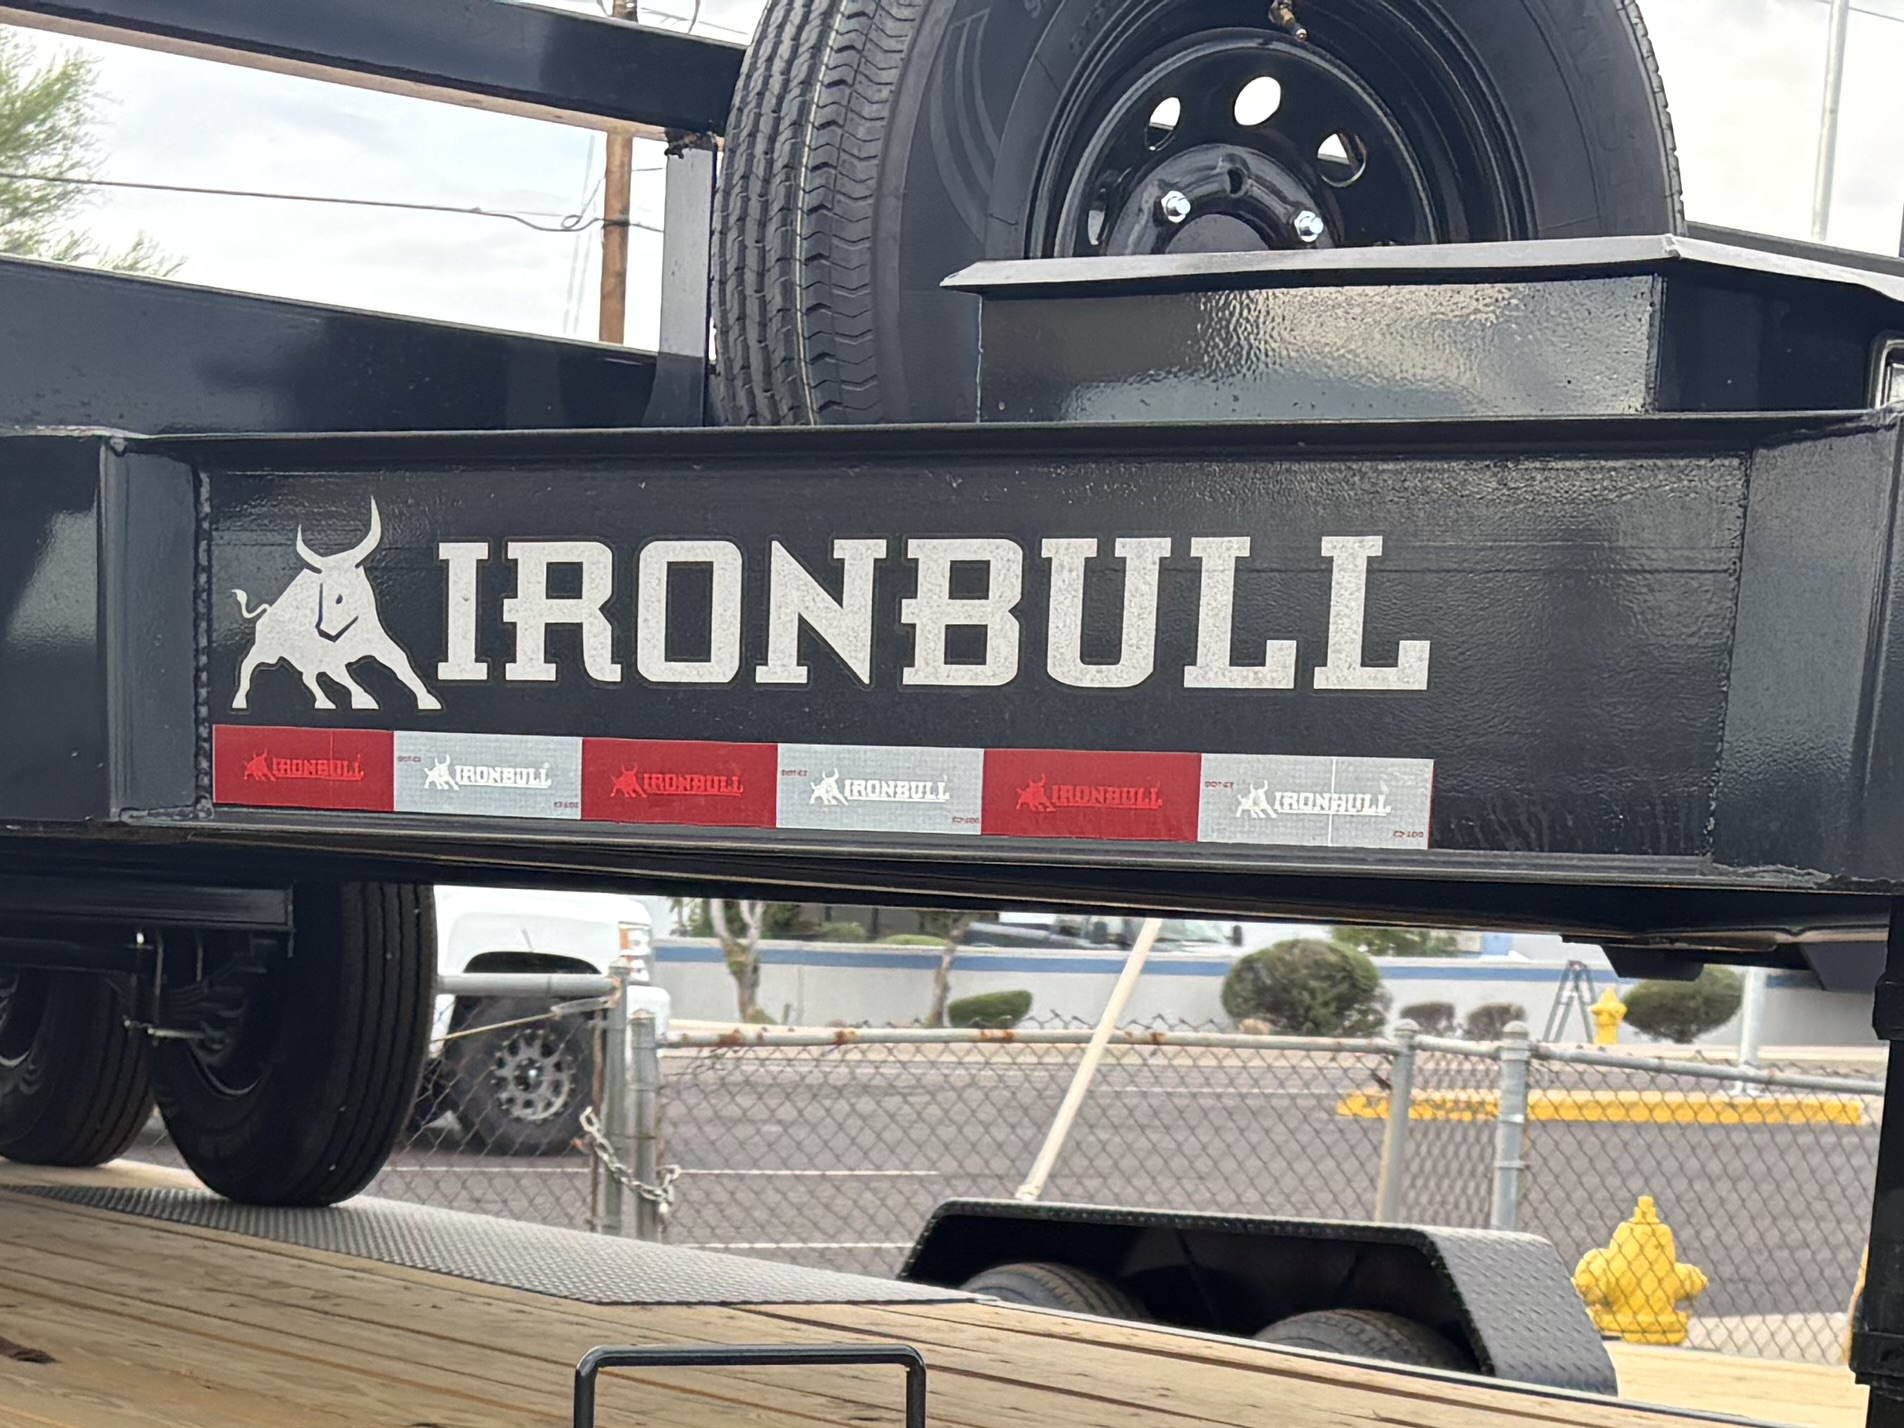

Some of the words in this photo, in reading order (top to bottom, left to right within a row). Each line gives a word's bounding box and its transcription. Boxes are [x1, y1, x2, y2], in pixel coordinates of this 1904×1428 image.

[436, 535, 1432, 691] IRONBULL
[454, 764, 553, 788] IRONBULL
[643, 772, 744, 797] IRONBULL
[844, 779, 951, 802] IRONBULL
[1051, 782, 1163, 810] IRONBULL
[1274, 790, 1391, 817] IRONBULL
